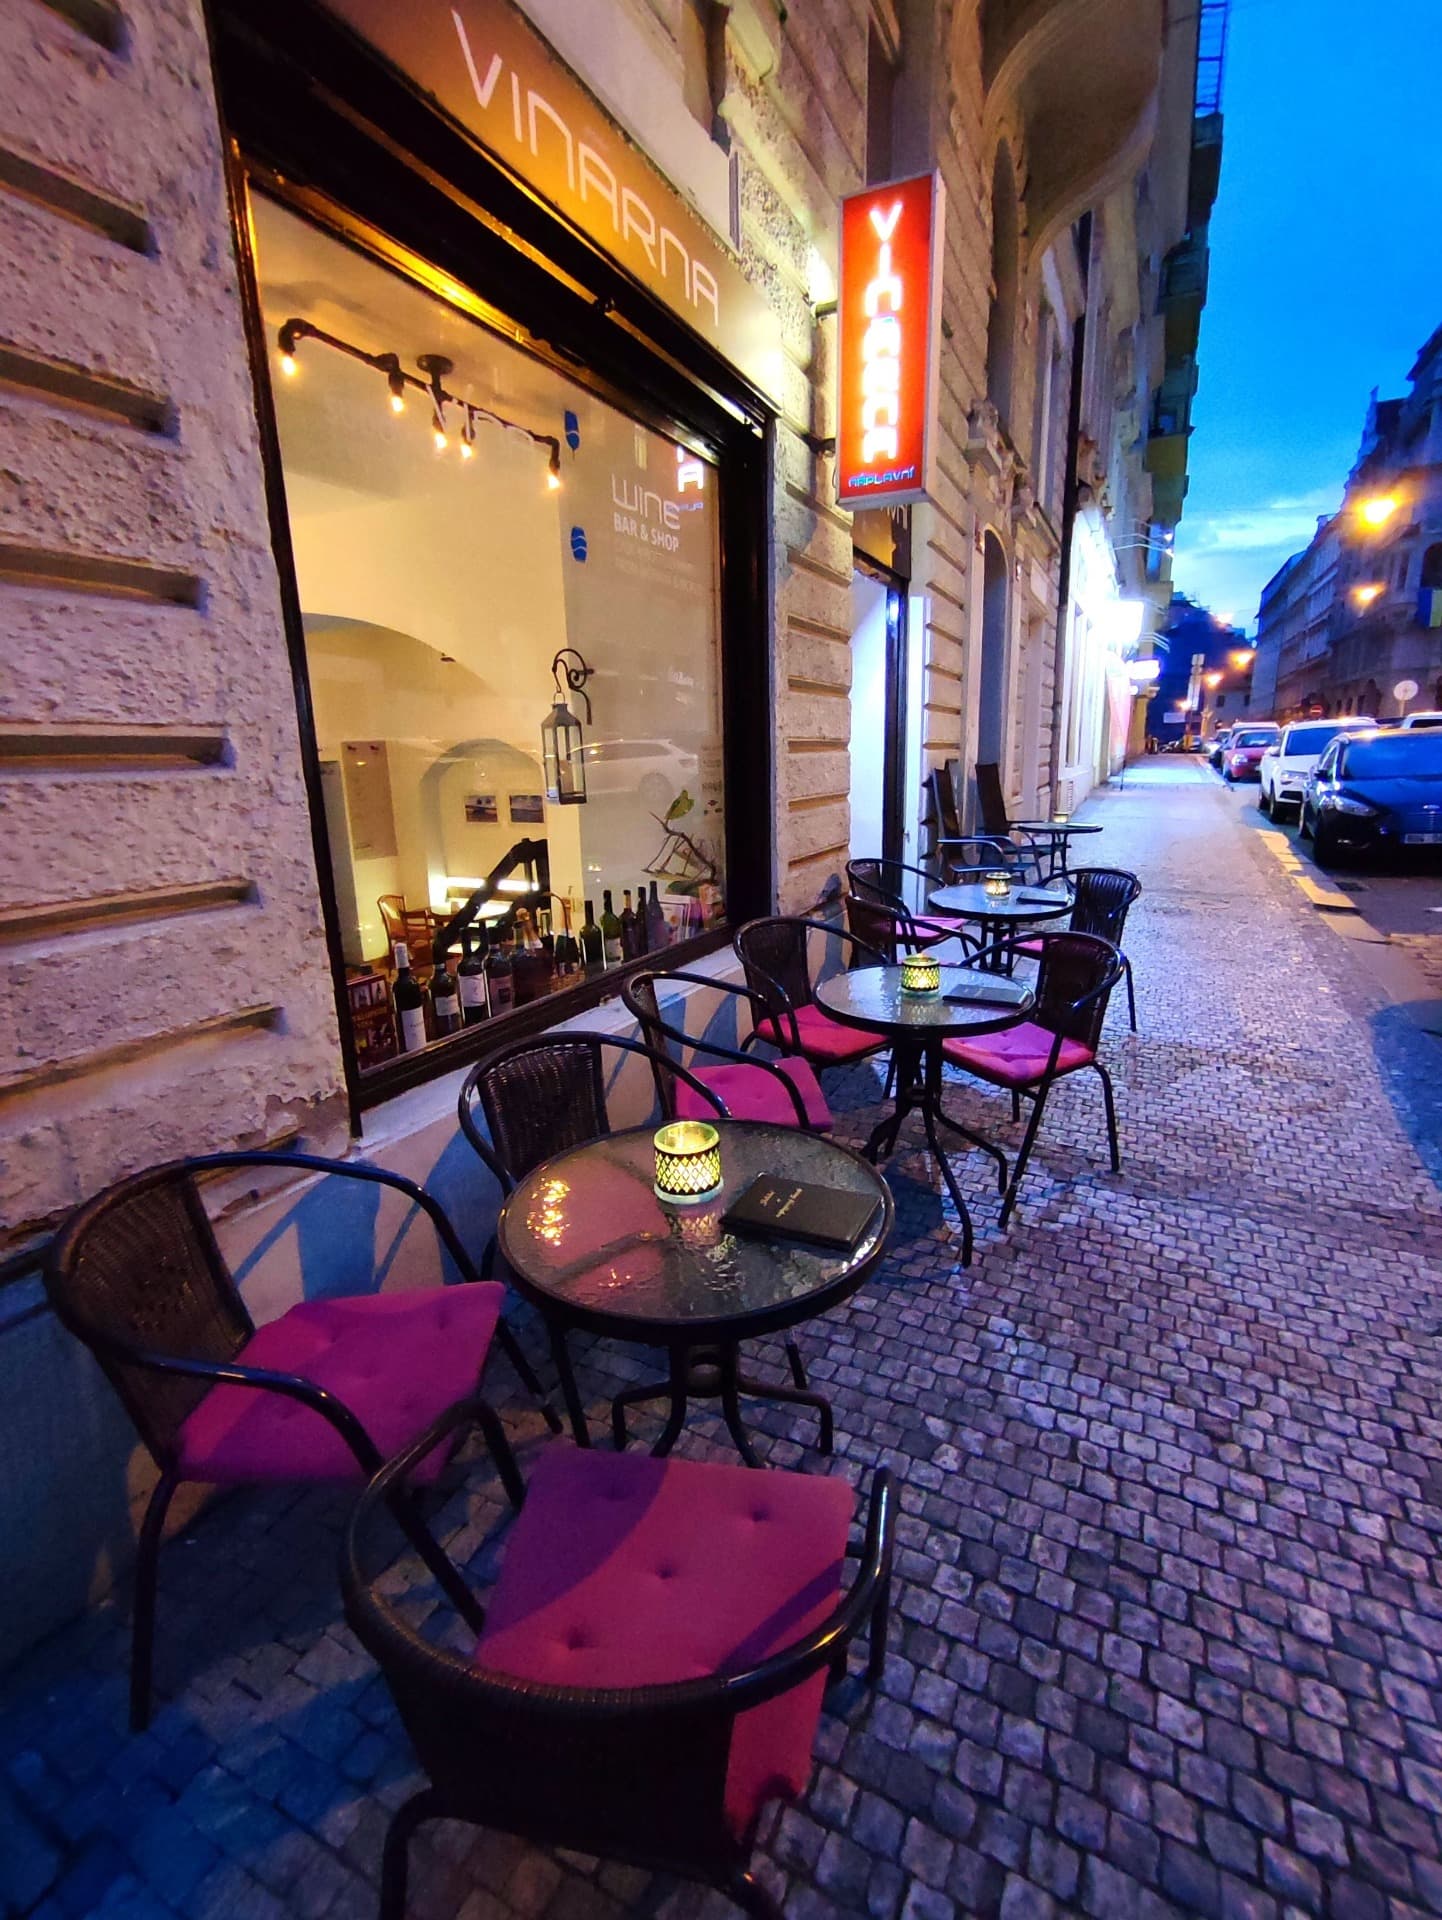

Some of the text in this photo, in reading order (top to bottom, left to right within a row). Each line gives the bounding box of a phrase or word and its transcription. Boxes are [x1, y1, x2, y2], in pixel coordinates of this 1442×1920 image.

[611, 473, 681, 530] WINE
[614, 511, 680, 553] BAR & SHOP
